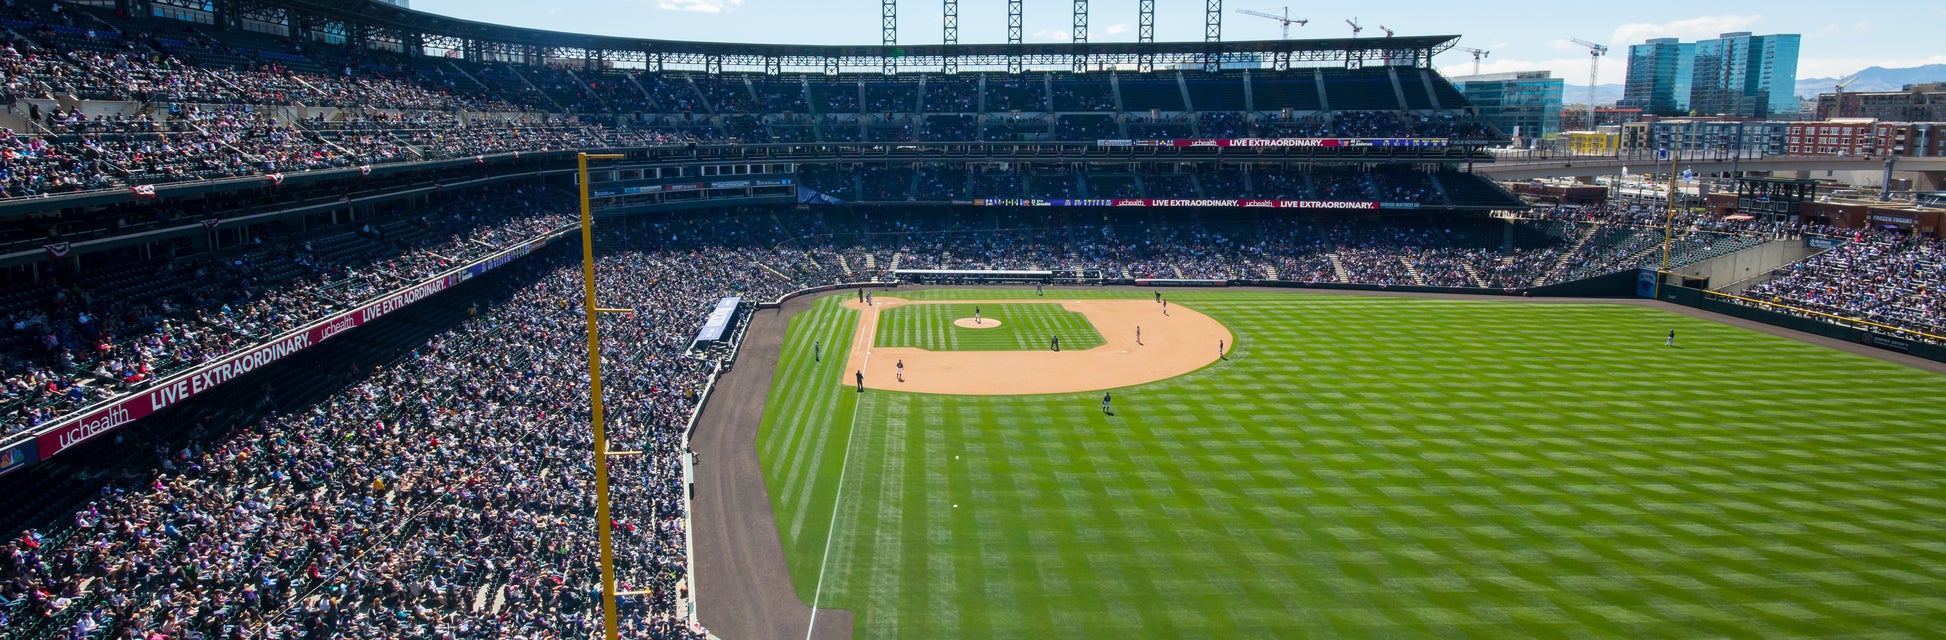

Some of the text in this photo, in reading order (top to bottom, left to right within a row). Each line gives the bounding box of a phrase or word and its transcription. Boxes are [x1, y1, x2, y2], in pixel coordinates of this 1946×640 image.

[1229, 139, 1323, 147] LIVE EXTRAORDINARY.
[1152, 199, 1239, 208] LIVE EXTRAORDINARY.
[1280, 200, 1298, 208] LIVE
[1299, 200, 1374, 209] EXTRAORDINARY.
[362, 278, 447, 323] LIVE EXTRAORDINARY.
[321, 314, 355, 340] uchealth
[151, 332, 312, 411] LIVE EXTRAORDINARY.
[59, 404, 129, 449] uchealth
